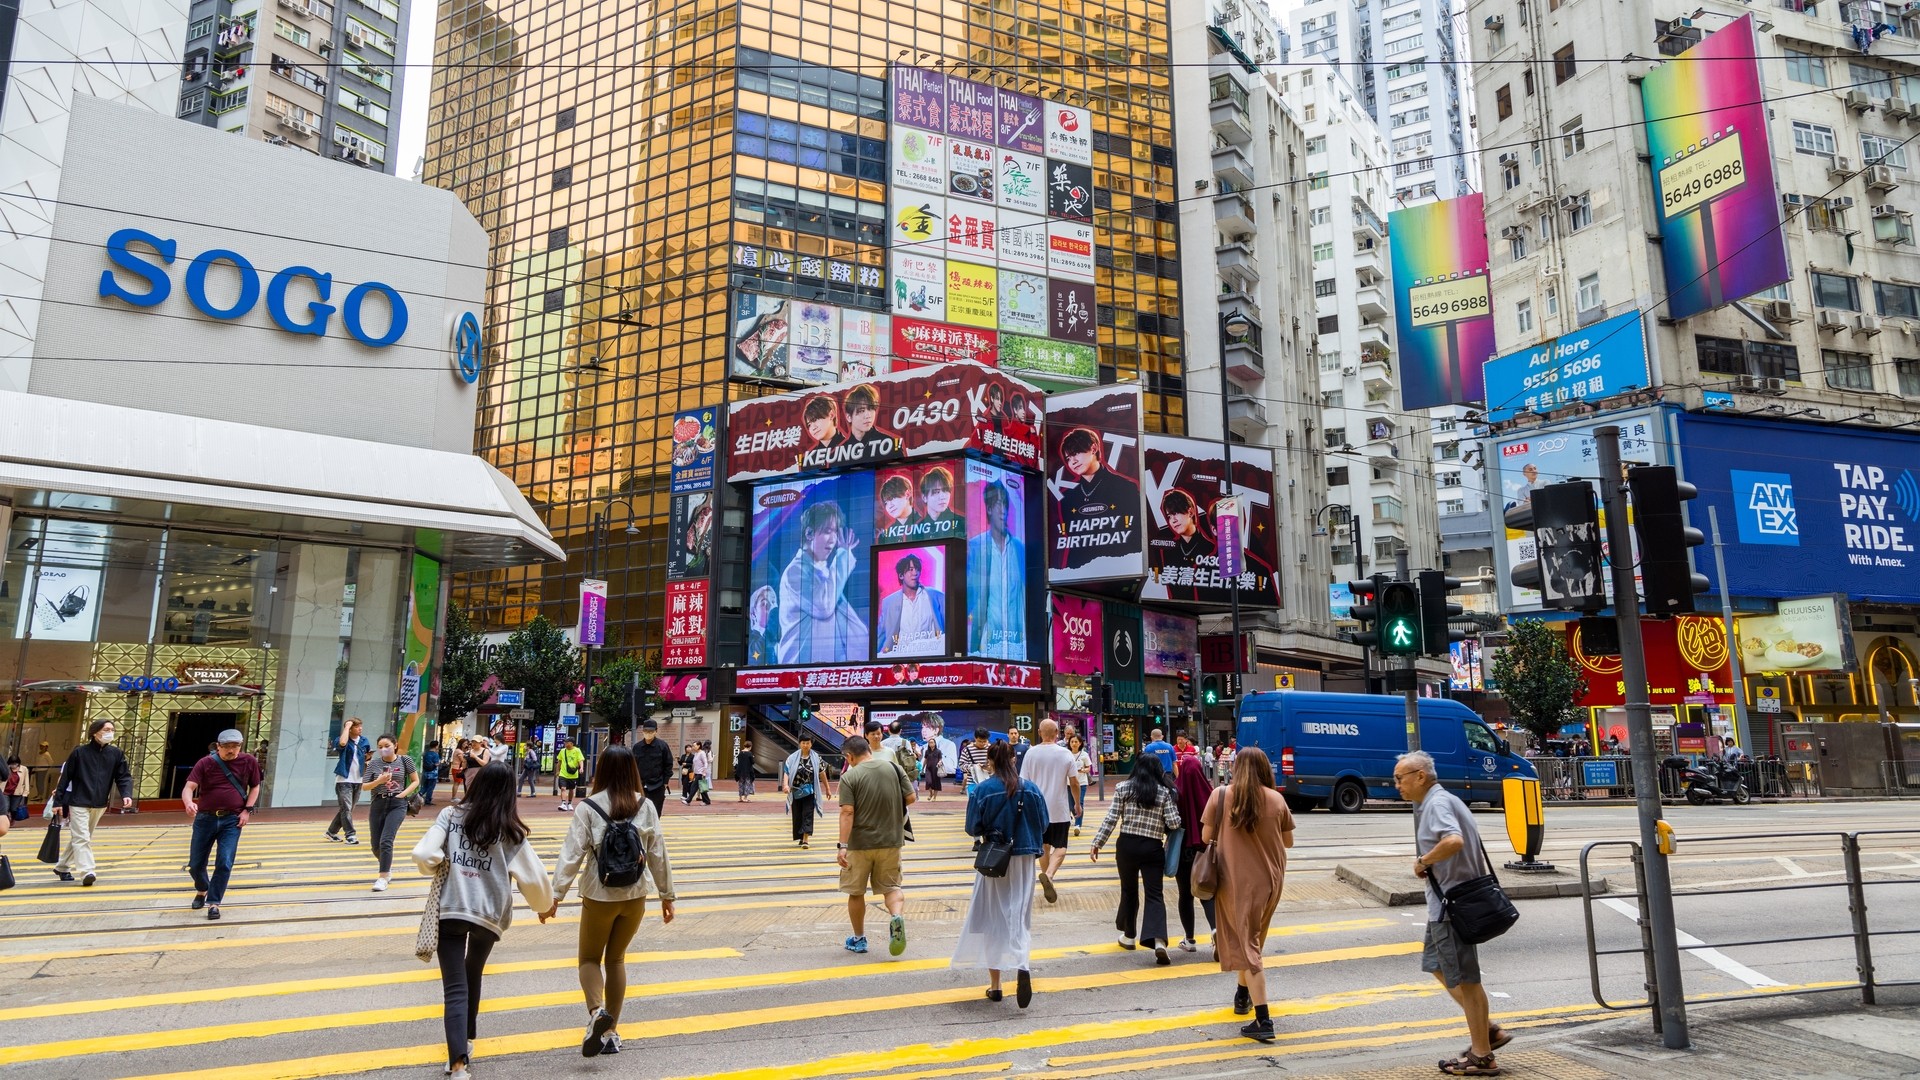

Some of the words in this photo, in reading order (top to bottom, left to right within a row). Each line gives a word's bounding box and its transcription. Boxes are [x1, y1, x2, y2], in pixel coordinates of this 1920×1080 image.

[897, 67, 922, 93] THAI
[923, 79, 942, 94] Perfect
[949, 79, 975, 106] THAI
[977, 92, 993, 106] Food
[999, 93, 1018, 111] THAI
[898, 92, 941, 128] 泰式食
[949, 103, 992, 139] 泰式料理
[1001, 125, 1011, 135] 8/F
[928, 136, 942, 146] 7/F
[1026, 162, 1040, 171] 7/F
[913, 173, 927, 181] 2668
[928, 176, 942, 184] 8483
[1662, 166, 1693, 188] 招租熱線
[1665, 180, 1702, 208] 5649
[1704, 160, 1742, 189] 6988
[949, 213, 994, 251] 金羅寶
[1001, 225, 1045, 251] 韓國料理
[1077, 229, 1090, 238] 6/F
[1068, 241, 1089, 252] 한국요리
[735, 245, 880, 287] 傷心酸辣粉
[902, 258, 937, 273] 新巴黎
[1030, 252, 1044, 261] 3986
[1077, 261, 1091, 270] 6398
[100, 228, 409, 348] SOGO
[1412, 290, 1442, 302] 招租熱線
[928, 296, 943, 305] 5/F
[982, 297, 994, 306] 5/F
[1413, 302, 1448, 318] 5649
[1451, 296, 1487, 312] 6988
[951, 305, 993, 317] 正宗重慶風味
[914, 325, 979, 348] 麻辣派對
[1528, 350, 1550, 368] Ad
[1554, 338, 1590, 360] Here
[1523, 368, 1558, 391] 9556
[1563, 354, 1602, 379] 5696
[1524, 375, 1605, 412] 廣告位招租
[893, 398, 961, 430] 0430
[734, 425, 802, 455] 生日快樂
[983, 429, 1035, 460] 姜濤生日快樂
[701, 456, 712, 465] 6/F
[675, 469, 693, 480] 金羅寶
[1834, 463, 1889, 491] TAP.
[1749, 482, 1796, 510] AM
[1839, 493, 1895, 521] PAY.
[1069, 515, 1121, 533] HAPPY
[1757, 507, 1799, 535] EX
[1057, 530, 1132, 550] BIRTHDAY
[1844, 523, 1915, 552] RIDE.
[669, 561, 676, 569] 3F
[1195, 555, 1220, 567] 0430
[1848, 553, 1873, 566] With
[1875, 556, 1905, 567] Amex.
[690, 582, 701, 590] 4/F
[1161, 565, 1256, 591] 姜濤生日樂
[672, 593, 703, 614] 麻辣
[671, 615, 703, 636] 派對
[992, 629, 1018, 640] HAPPY
[1070, 637, 1085, 652] 莎莎
[666, 657, 683, 665] 2178
[684, 656, 703, 665] 4898
[118, 676, 179, 692] SOGO
[806, 671, 873, 686] 姜濤生日快樂
[922, 676, 947, 684] KEUNG
[1309, 722, 1360, 736] BRINKS
[458, 834, 489, 858] long
